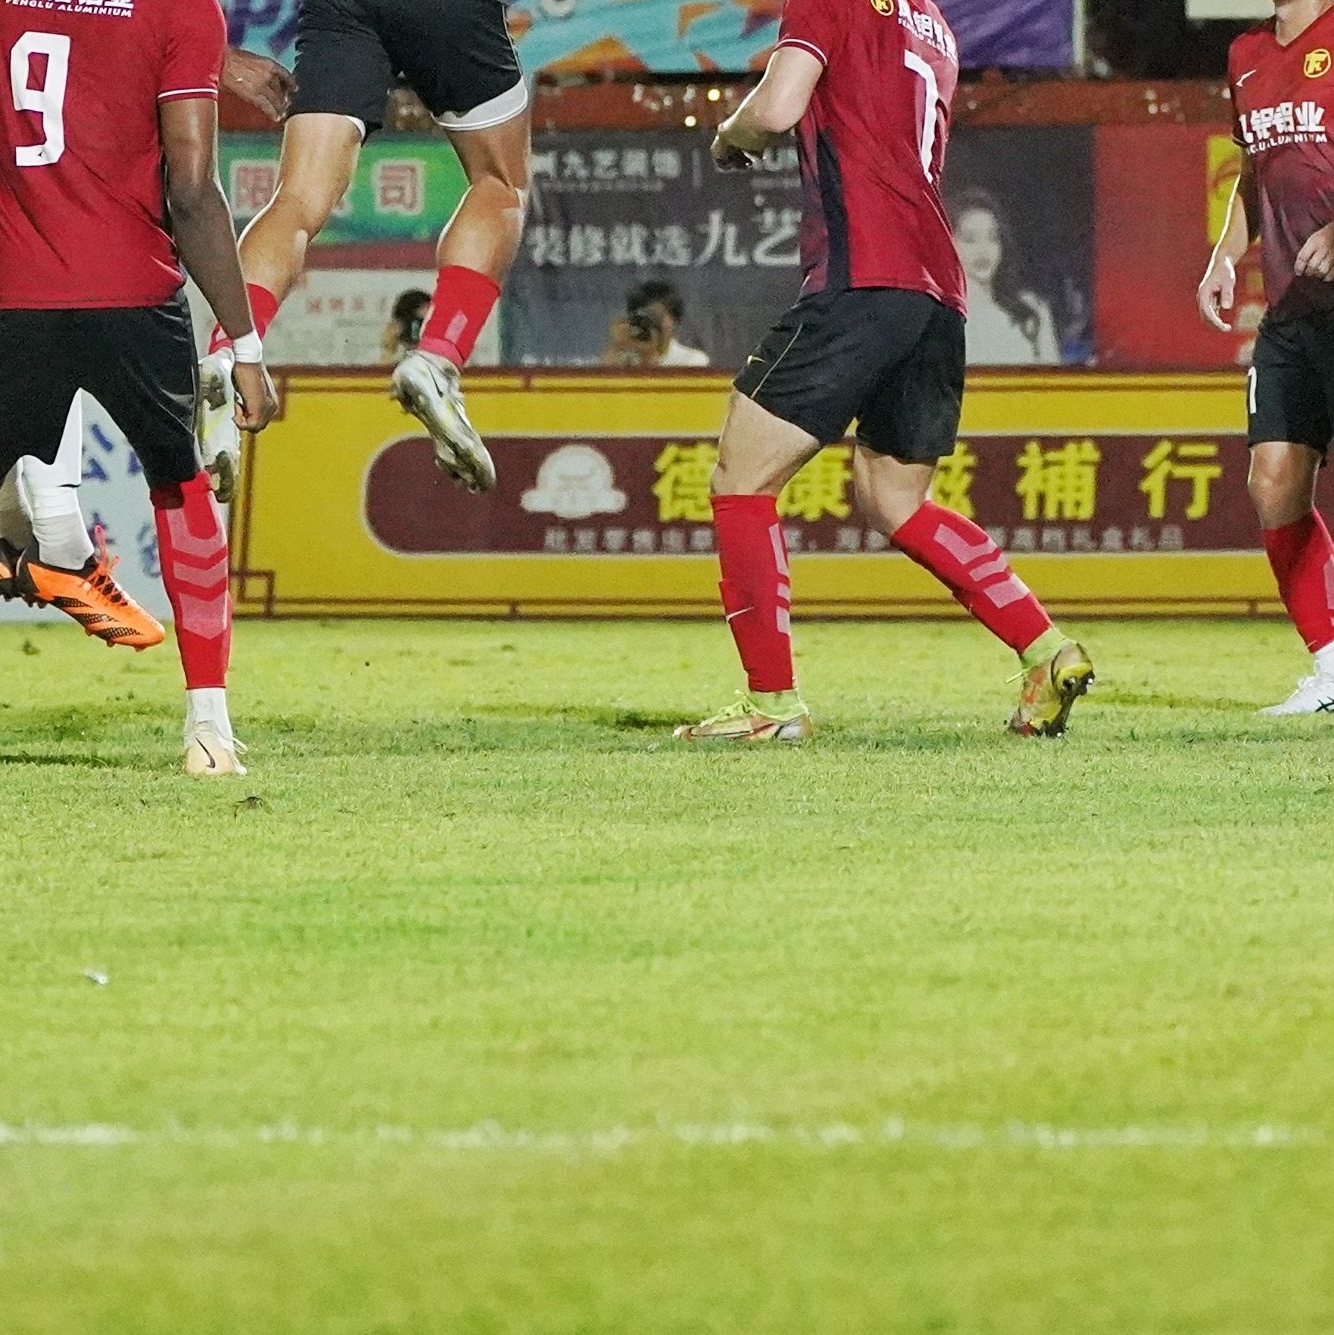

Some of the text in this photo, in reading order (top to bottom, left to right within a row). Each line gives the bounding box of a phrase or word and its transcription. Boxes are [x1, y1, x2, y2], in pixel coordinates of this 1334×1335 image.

[57, 4, 132, 17] ALUMINIUM
[9, 31, 71, 166] 9
[904, 49, 938, 182] 7
[1238, 102, 1326, 144] 铝铝业
